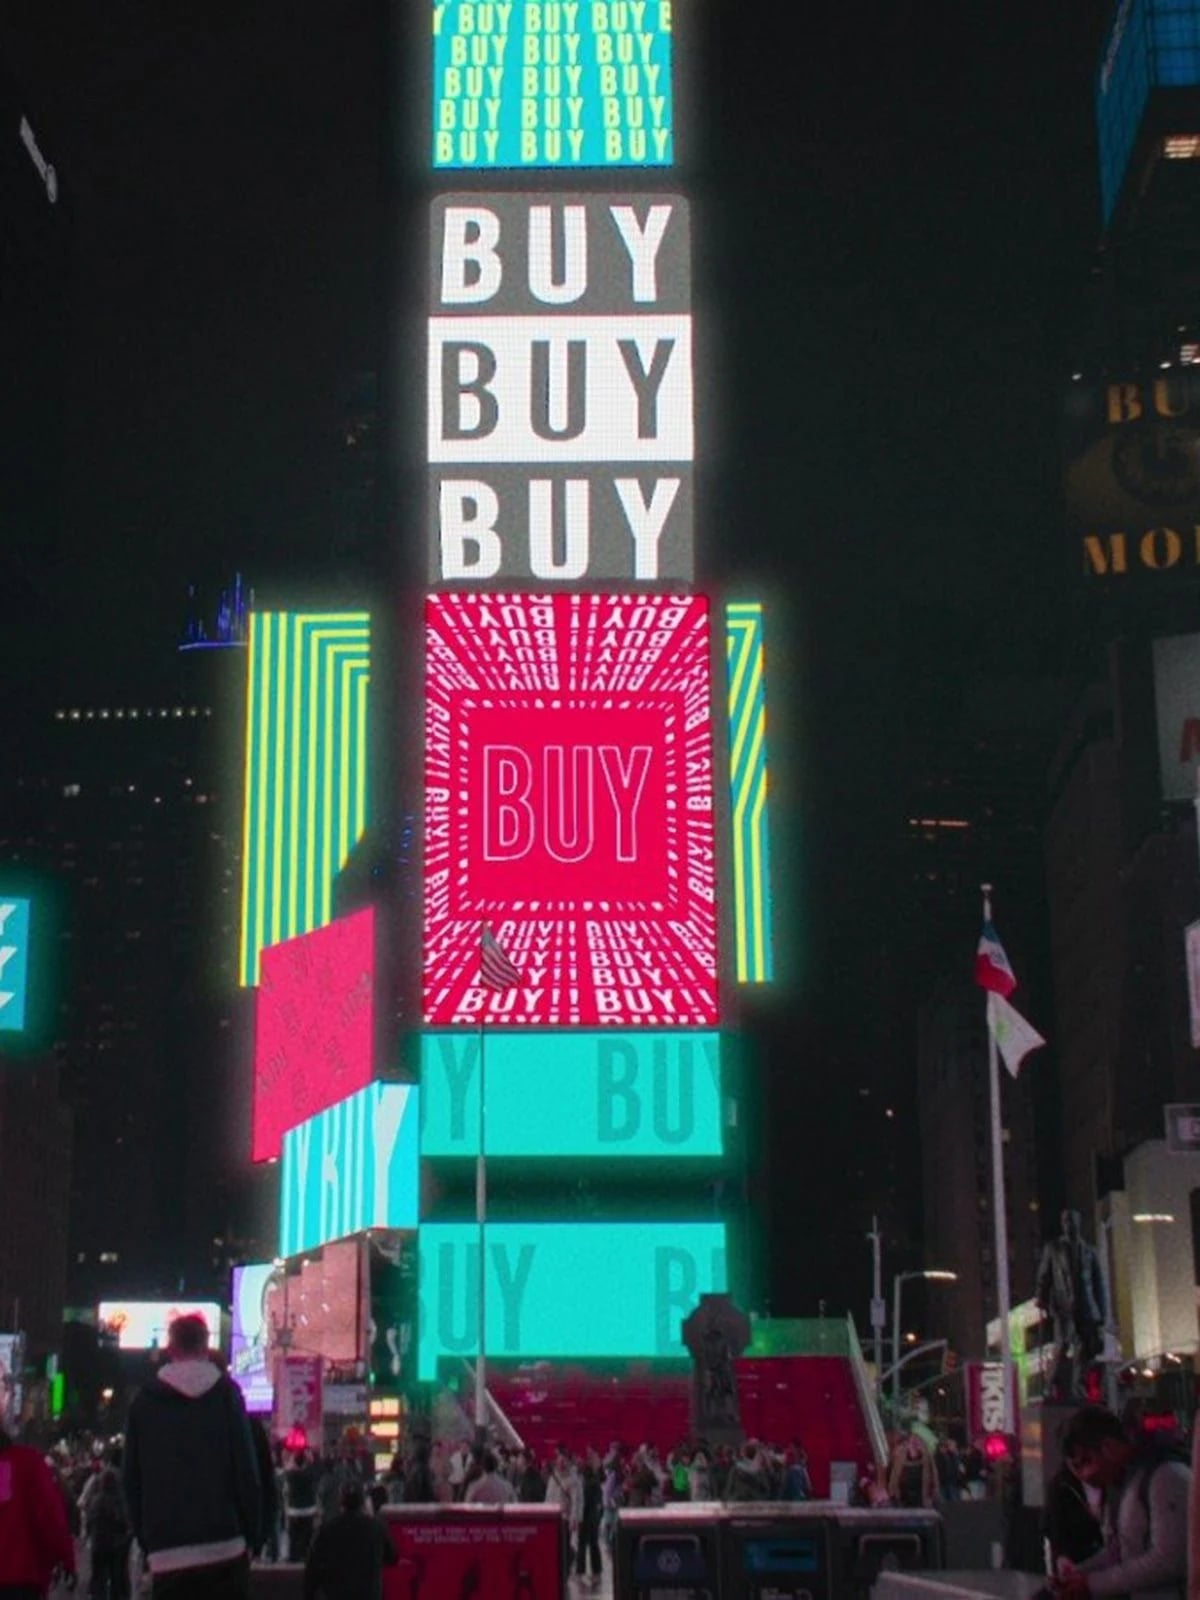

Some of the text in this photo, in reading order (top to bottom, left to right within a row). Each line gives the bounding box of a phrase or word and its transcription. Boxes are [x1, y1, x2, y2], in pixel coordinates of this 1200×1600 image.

[458, 3, 512, 34] BUY
[524, 2, 579, 33] BUY
[592, 1, 646, 33] BUY
[451, 32, 653, 66] BUY BUY BUY
[445, 64, 660, 98] BUY BUY BUY
[440, 96, 665, 130] BUY BUY BUY
[436, 128, 669, 163] BUY BUY BUY
[440, 205, 673, 305] BUY
[441, 339, 675, 441] BUY
[440, 478, 681, 581] BUY
[1083, 525, 1200, 575] MO
[483, 745, 653, 863] BUY
